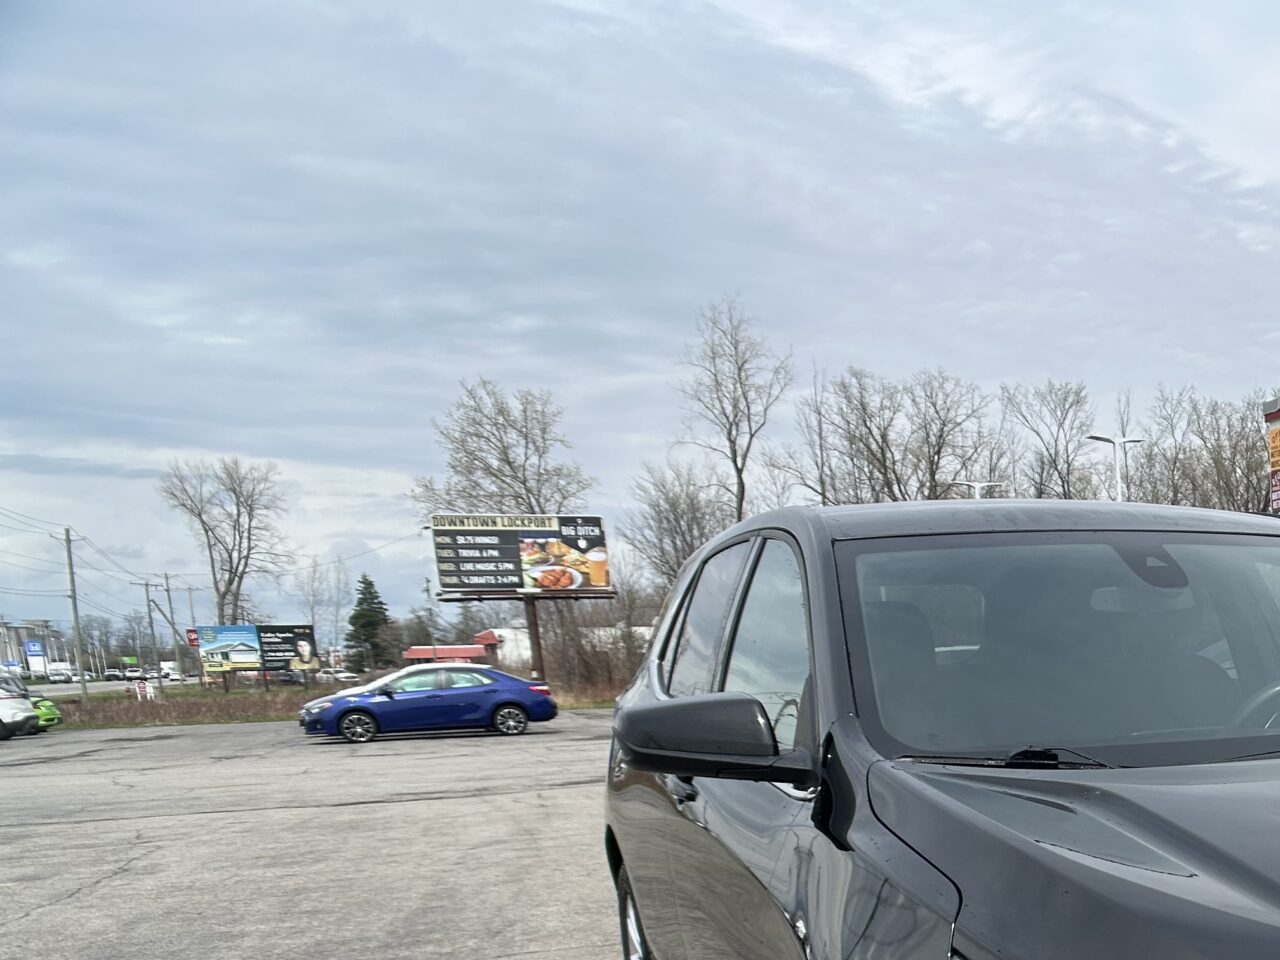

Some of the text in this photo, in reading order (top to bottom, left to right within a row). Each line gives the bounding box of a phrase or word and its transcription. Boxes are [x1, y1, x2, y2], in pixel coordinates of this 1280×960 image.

[433, 517, 553, 528] DOWNTOWN LOCKPORT
[561, 526, 600, 536] BIG DITCH
